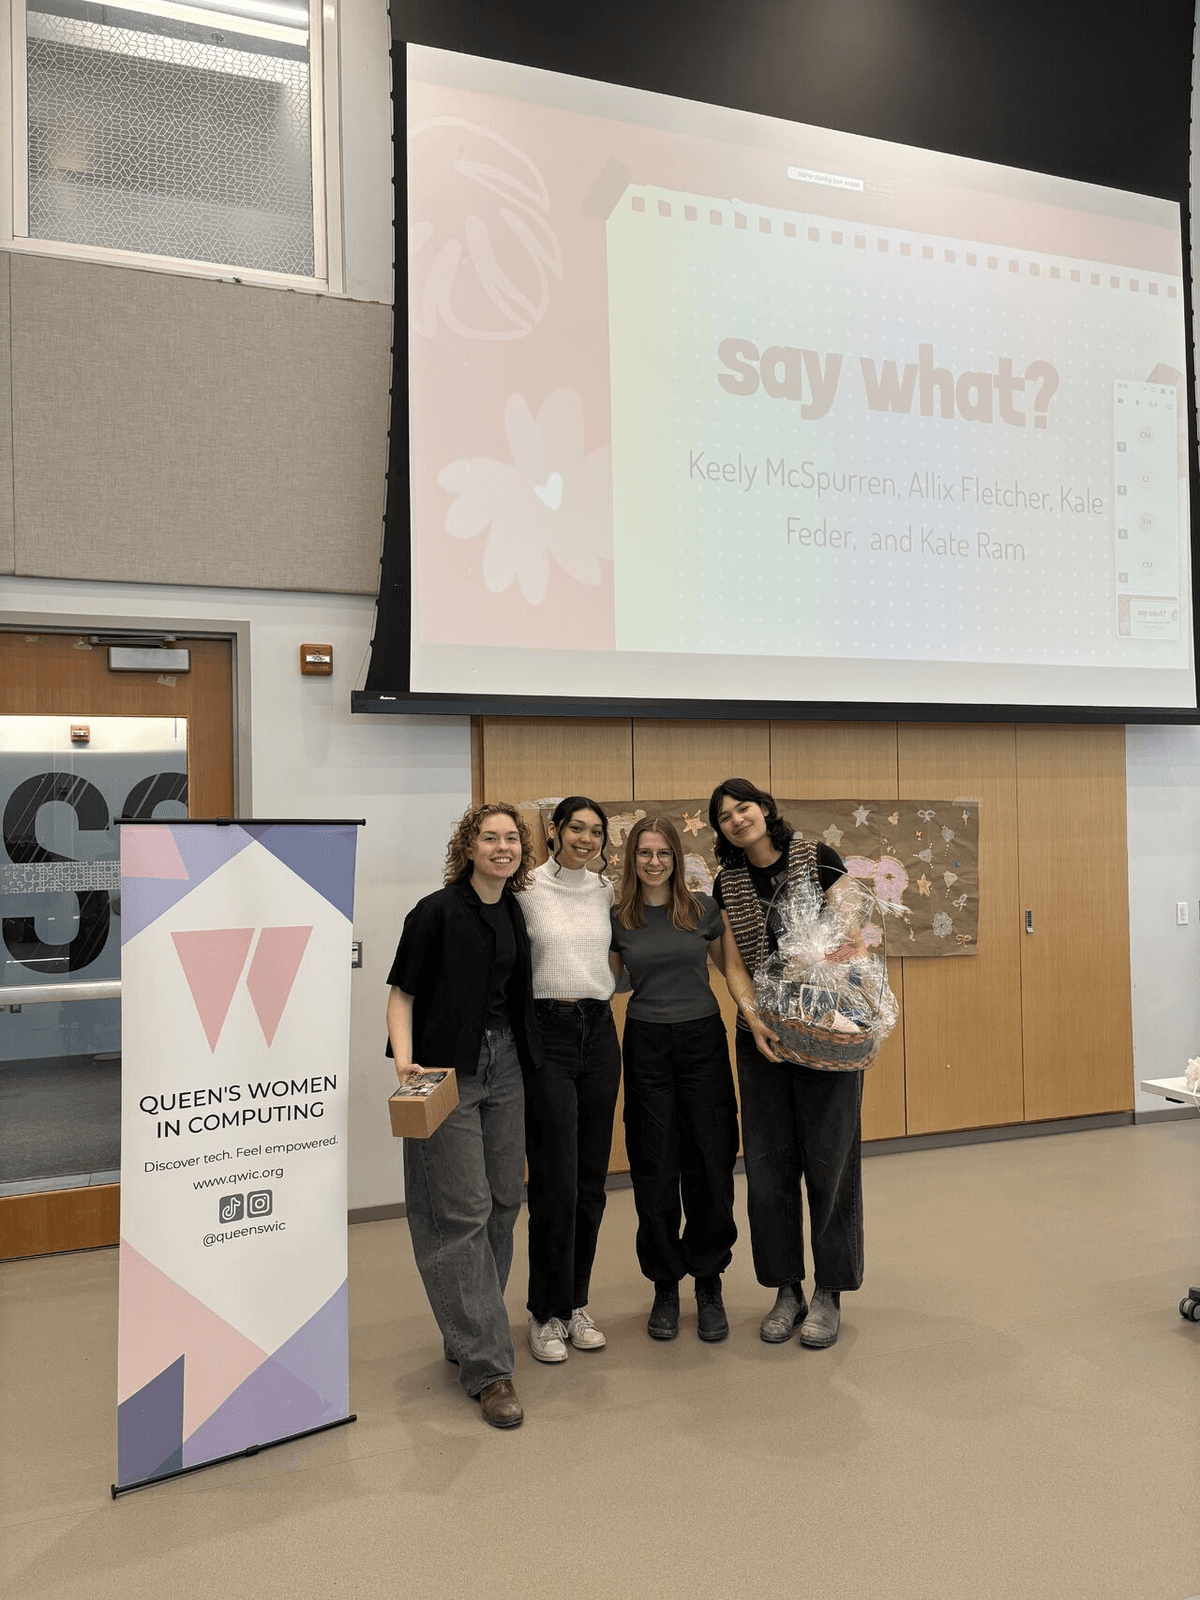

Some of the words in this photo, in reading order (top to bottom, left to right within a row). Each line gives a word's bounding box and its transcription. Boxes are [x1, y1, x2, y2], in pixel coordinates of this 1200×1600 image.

[717, 338, 843, 421] say
[859, 343, 1060, 430] what?
[688, 450, 758, 493] Keely
[765, 457, 901, 500] McSpurren,
[908, 472, 955, 502] Allix
[961, 476, 1054, 515] Fletcher,
[1060, 486, 1105, 515] Kale
[786, 517, 858, 552] Feder,
[870, 525, 913, 553] and
[920, 528, 970, 558] Kate
[977, 532, 1026, 562] Ram
[139, 1084, 241, 1116] QUEEN'S
[247, 1074, 338, 1100] WOMEN
[157, 1119, 180, 1139] IN
[188, 1101, 325, 1134] COMPUTING
[144, 1156, 200, 1173] Discover
[203, 1149, 233, 1164] tech.
[236, 1144, 262, 1158] Feel
[264, 1134, 339, 1155] empowered.
[193, 1166, 284, 1190] www.qwic.org
[202, 1219, 286, 1248] @queenswic
